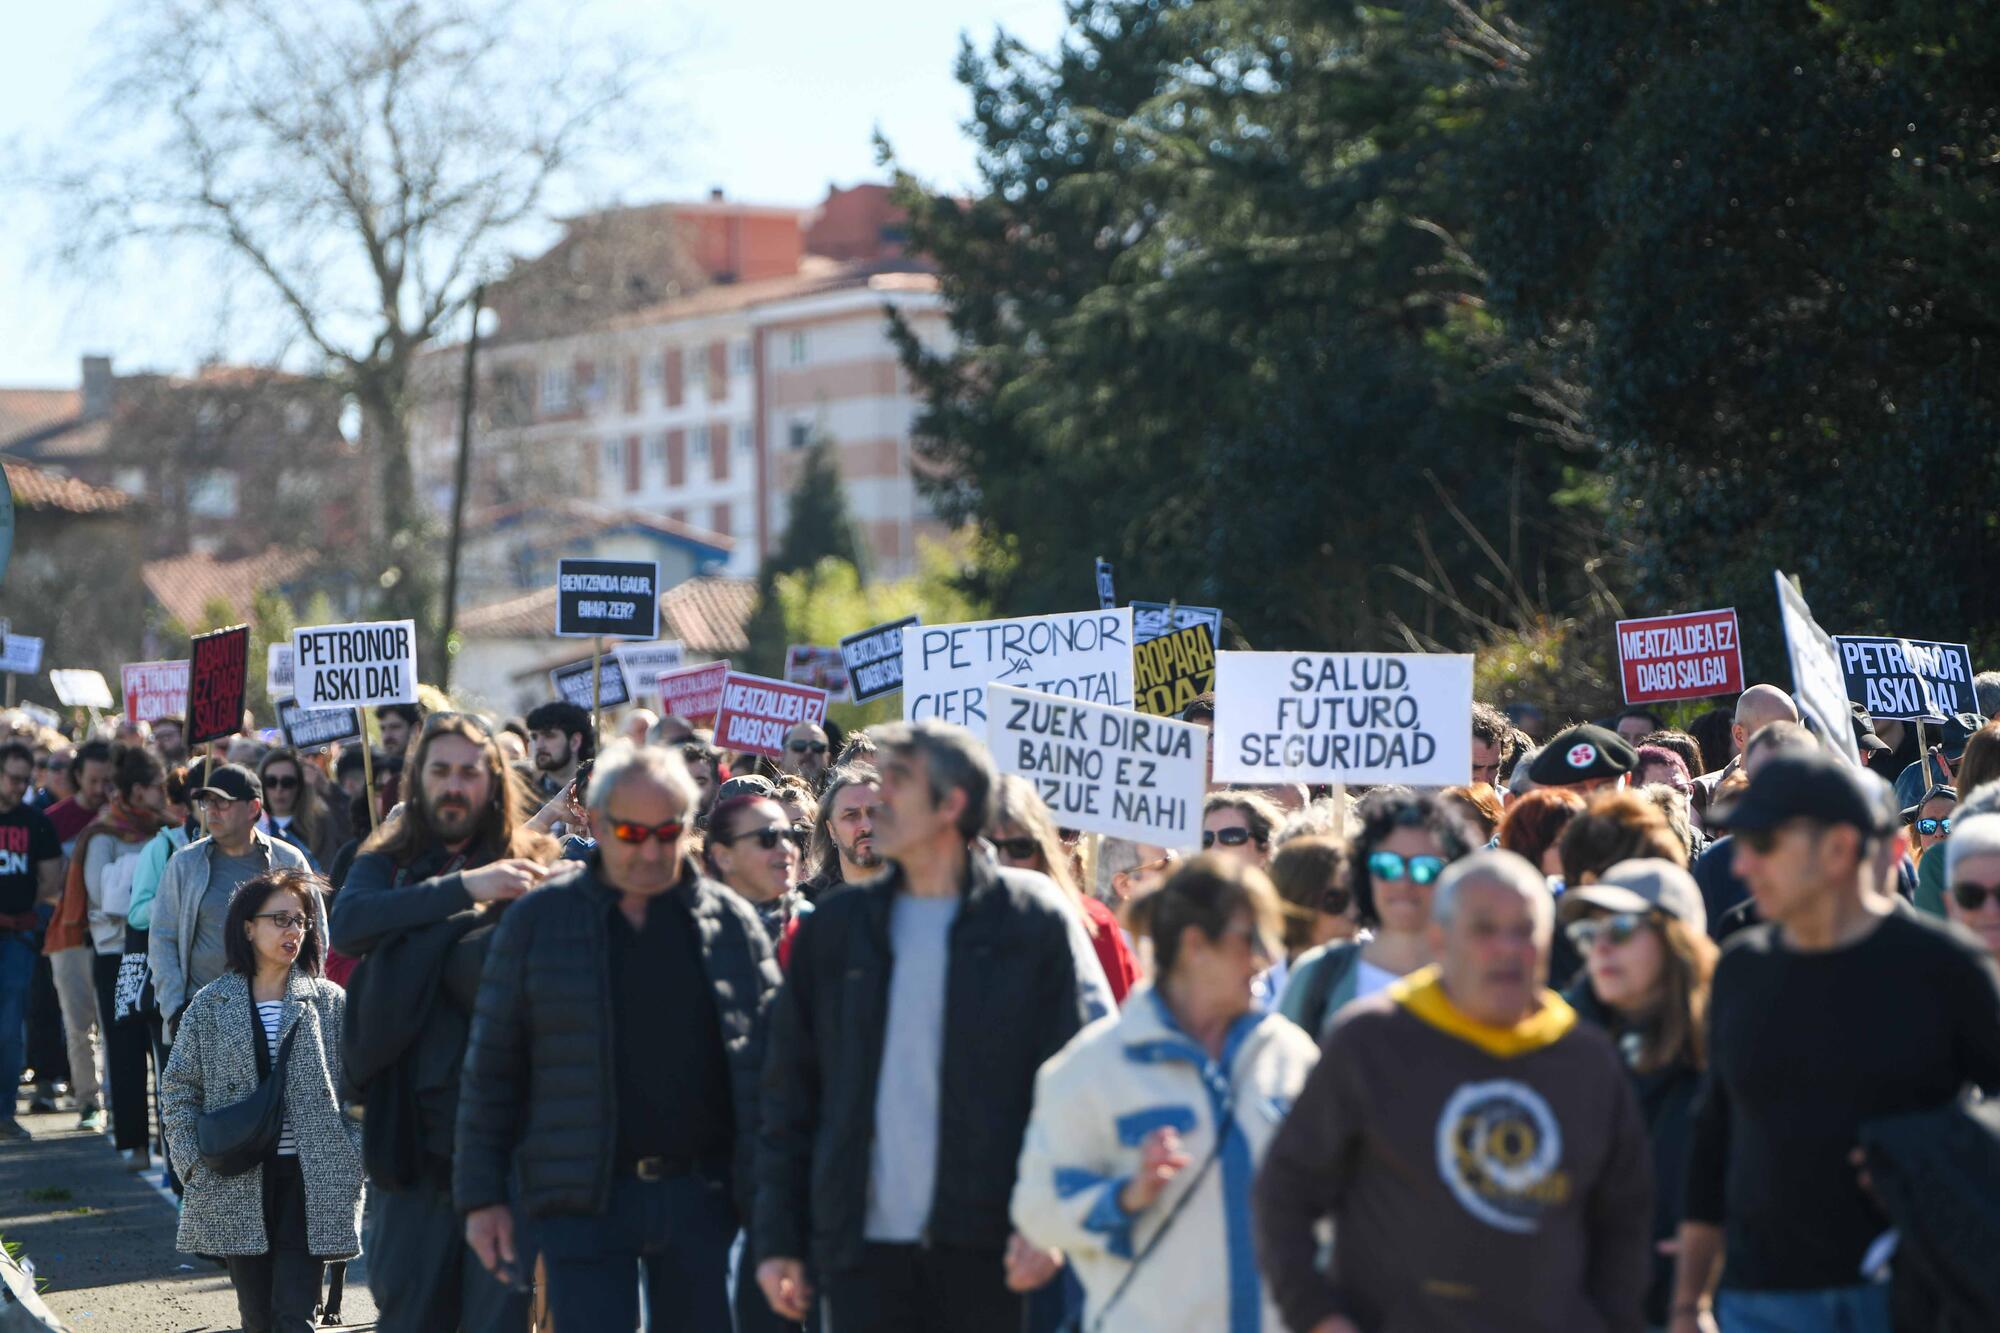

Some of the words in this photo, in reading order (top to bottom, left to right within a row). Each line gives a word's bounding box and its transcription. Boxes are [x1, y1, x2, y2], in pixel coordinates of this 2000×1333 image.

[578, 600, 607, 618] BIHAR
[608, 601, 636, 619] ZER?
[300, 628, 409, 666] PETRONOR
[922, 616, 1125, 670] PETRONOR
[1622, 623, 1715, 660] MEATZALDEA
[1715, 621, 1735, 650] EZ
[996, 658, 1033, 679] YA
[1290, 657, 1409, 692] SALUD,
[1636, 662, 1676, 692] DAGO
[1676, 656, 1727, 689] SALGAI
[1842, 642, 1965, 683] PETRONOR
[313, 668, 360, 702] ASKI
[366, 665, 400, 698] DA!
[1866, 677, 1920, 713] ASKI
[722, 683, 803, 721] MEATZALDEA
[804, 697, 822, 723] EZ
[1277, 695, 1420, 730] FUTURO,
[727, 716, 762, 745] DAGO
[1006, 698, 1087, 740] ZUEK
[1101, 713, 1192, 759] DIRUA
[1018, 739, 1103, 780] BAINO
[1116, 757, 1156, 787] EZ
[1240, 732, 1436, 769] SEGURIDAD
[1112, 790, 1186, 831] NAHI
